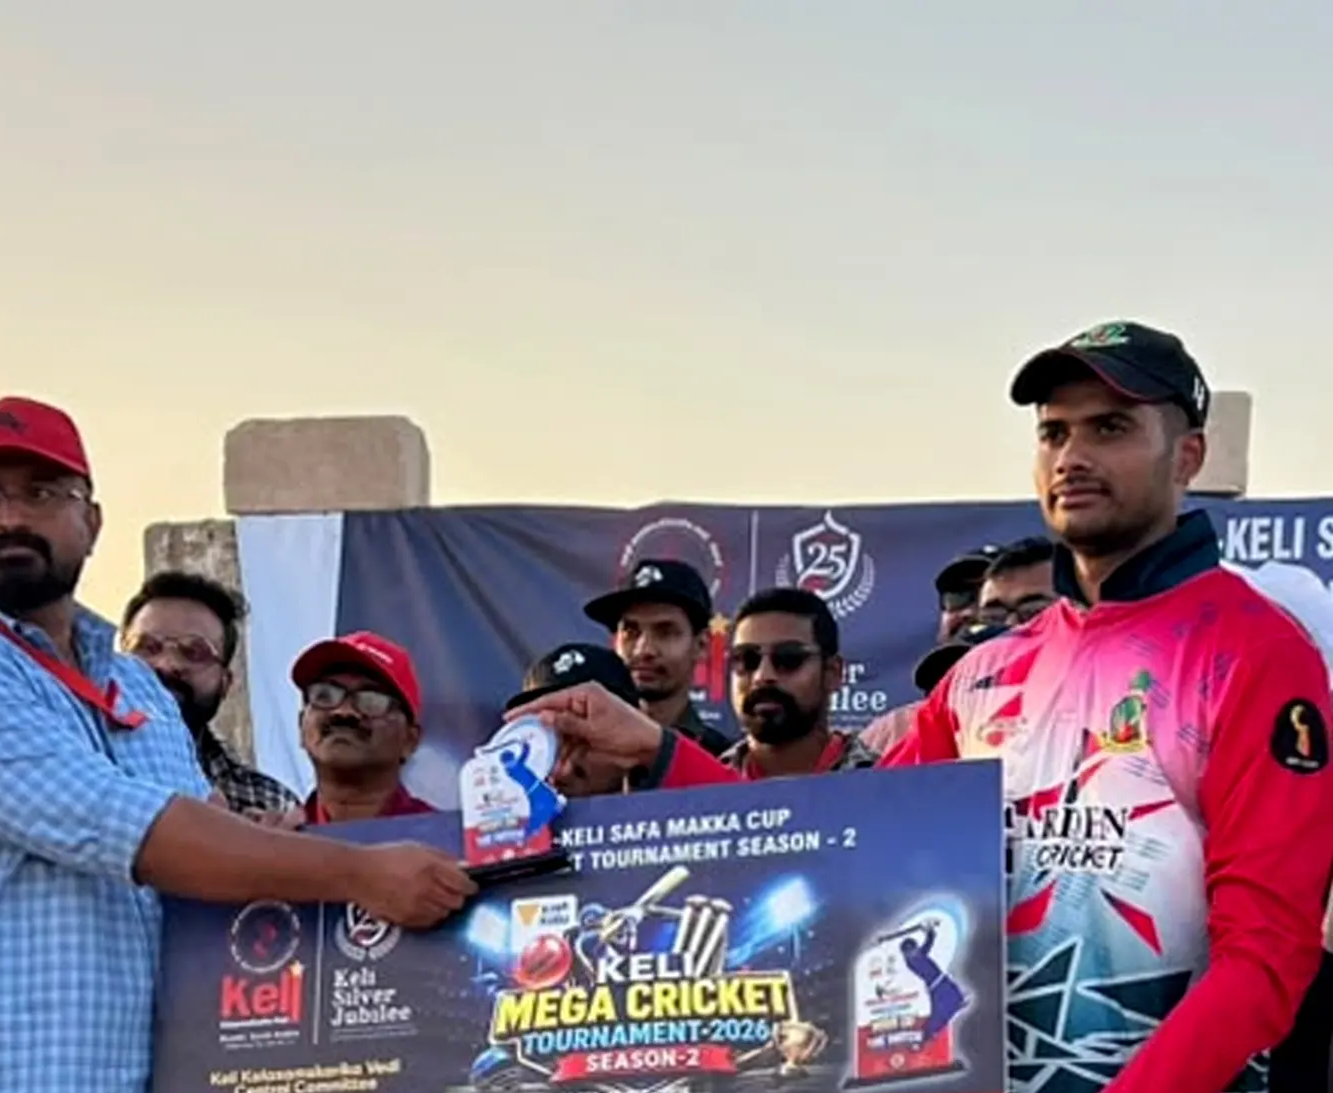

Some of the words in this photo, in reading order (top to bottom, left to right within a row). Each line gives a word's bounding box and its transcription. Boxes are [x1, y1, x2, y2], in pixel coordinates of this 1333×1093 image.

[807, 542, 848, 578] 25
[609, 822, 661, 845] SAFA
[666, 814, 742, 837] MAKKA
[746, 808, 792, 830] CUP
[589, 842, 731, 870] TOURNAMENT
[736, 833, 820, 858] SEASON
[842, 828, 857, 848] 2
[1036, 844, 1126, 868] CRICKET
[333, 966, 377, 988] Keli
[597, 952, 694, 985] KELI
[219, 966, 303, 1025] Keli
[333, 987, 397, 1007] Silver
[495, 985, 615, 1033] MEGA
[627, 976, 790, 1019] CRICKET
[331, 1005, 412, 1027] Jubilee
[523, 1020, 771, 1055] TOURNAMENT-2026
[585, 1050, 701, 1073] SEASON-2
